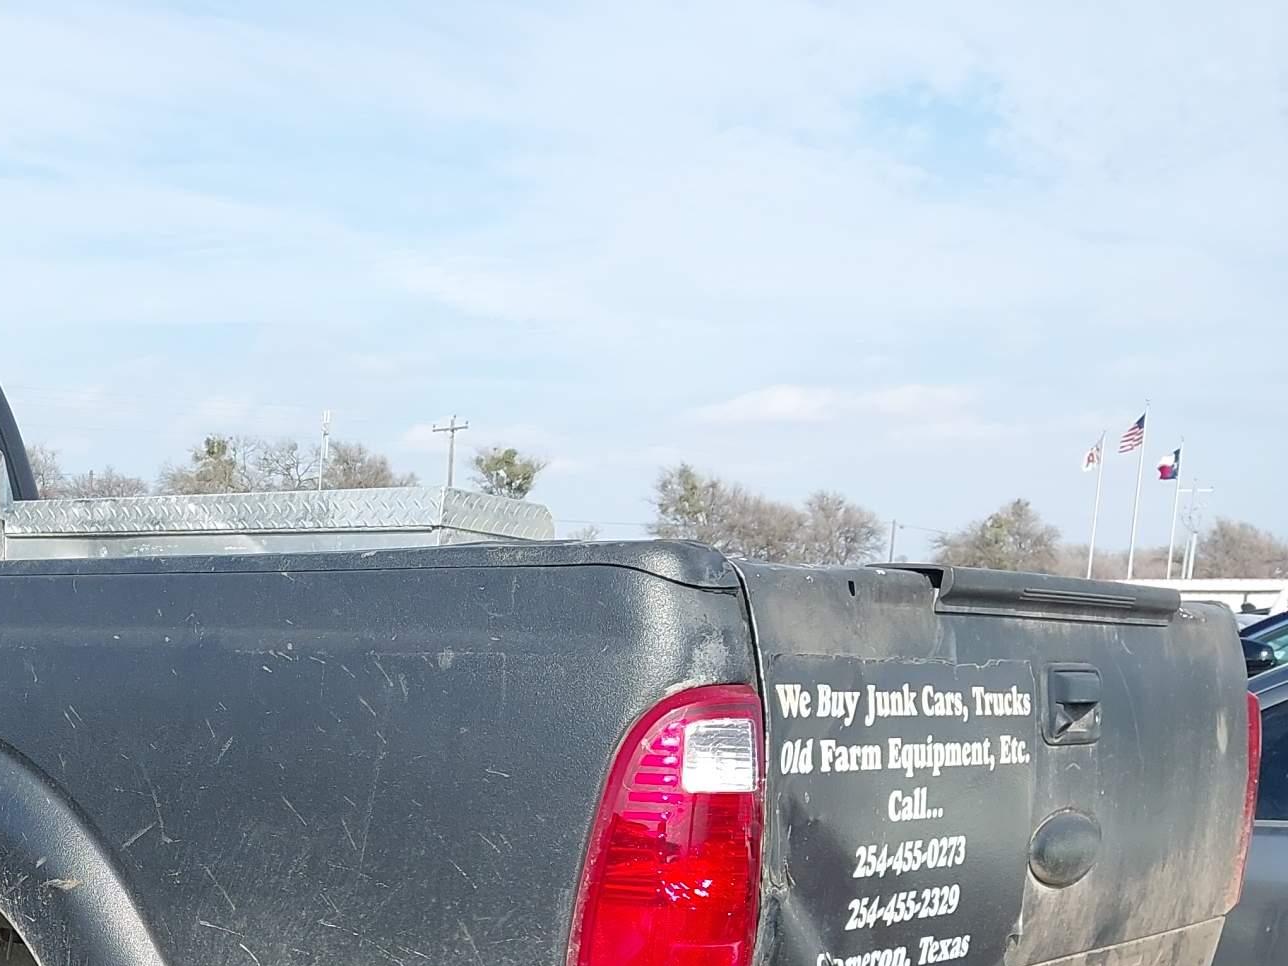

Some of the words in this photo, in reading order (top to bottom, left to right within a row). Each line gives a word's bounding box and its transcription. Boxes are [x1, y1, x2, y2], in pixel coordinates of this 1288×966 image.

[775, 683, 812, 719] We
[816, 683, 860, 727] Buy
[865, 683, 918, 727] Junk
[922, 684, 969, 723] Cars,
[971, 685, 1032, 717] Trucks
[780, 738, 814, 775] Old
[819, 739, 883, 773] Farm
[887, 734, 996, 778] Equipment,
[999, 734, 1031, 765] Etc.
[888, 786, 944, 822] Call...
[852, 835, 967, 879] 254-455-0273
[844, 883, 961, 932] 254-455-2329
[917, 934, 972, 966] Texas
